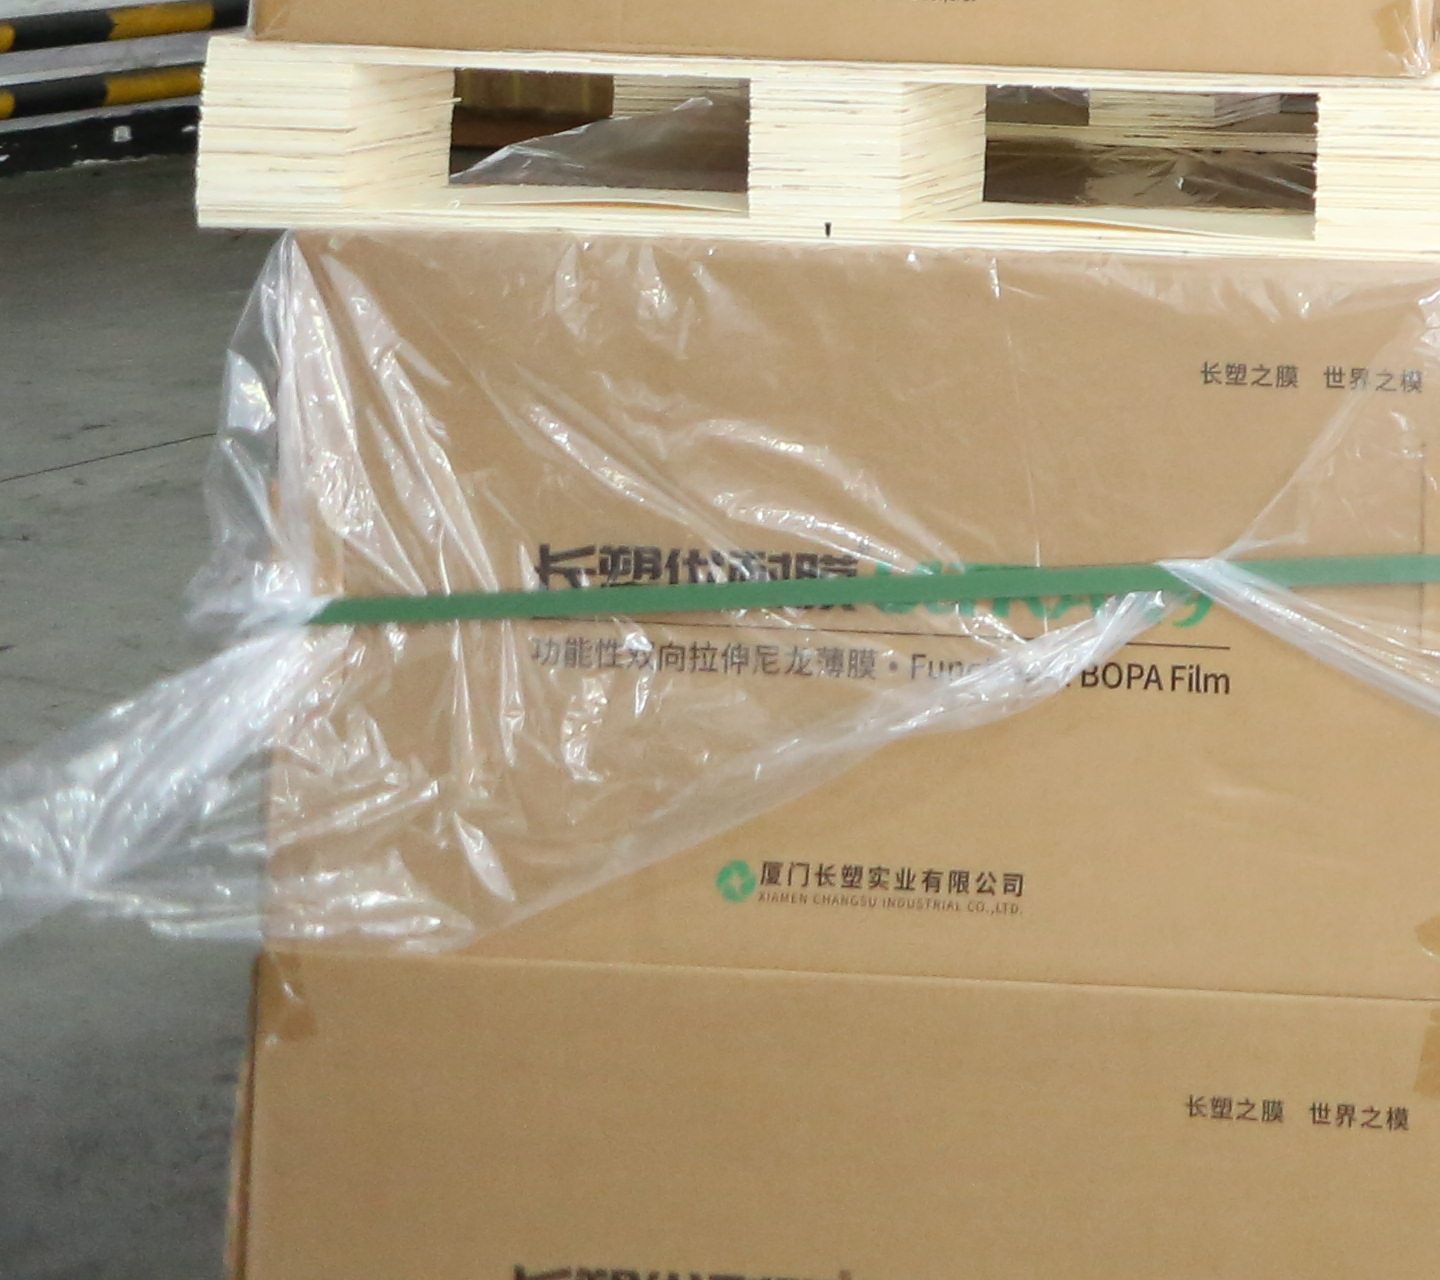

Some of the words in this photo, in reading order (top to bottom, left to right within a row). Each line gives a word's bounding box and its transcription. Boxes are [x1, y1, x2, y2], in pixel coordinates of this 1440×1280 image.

[1200, 360, 1299, 389] 长塑之膜
[1323, 364, 1423, 394] 世界之模
[1081, 662, 1164, 691] BOPA
[1171, 663, 1231, 695] Film
[760, 861, 1025, 898] 厦门长塑实业有限公司
[758, 891, 808, 905] XIAMEN
[812, 893, 877, 909] CHANGSU
[881, 895, 961, 912] INDUSTRIAL
[1187, 1094, 1285, 1124] 长塑之膜
[1309, 1100, 1410, 1132] 世界之模
